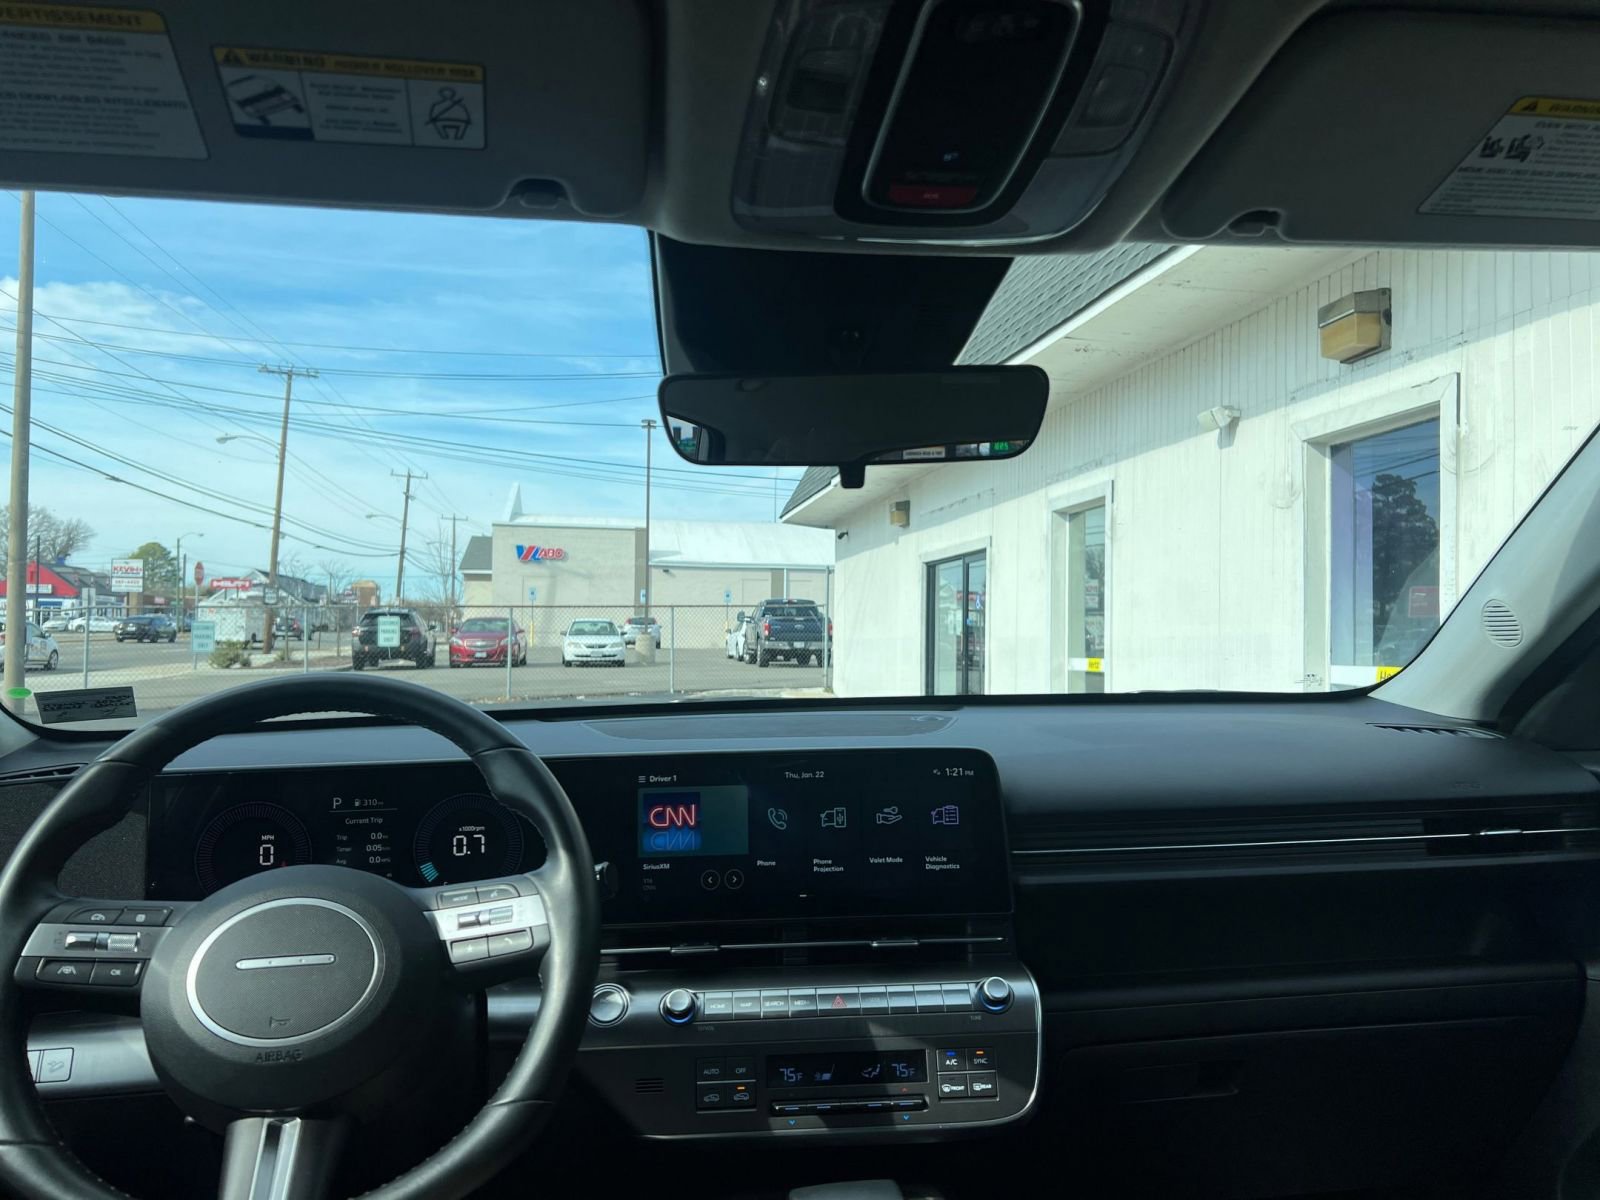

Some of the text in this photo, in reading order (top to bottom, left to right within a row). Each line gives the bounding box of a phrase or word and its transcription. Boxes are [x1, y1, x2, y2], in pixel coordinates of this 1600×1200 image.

[801, 771, 815, 779] Jan.
[816, 770, 825, 778] 22
[945, 767, 964, 777] 1:21
[649, 774, 678, 783] Driver 1
[333, 797, 342, 809] P
[649, 803, 696, 827] CNN
[345, 816, 383, 825] Current Trip
[453, 834, 485, 856] 0.7
[259, 843, 274, 866] 0
[925, 855, 947, 863] Vehicle
[813, 858, 833, 866] Phone
[869, 856, 885, 864] Valet
[643, 863, 670, 871] SiriusXM
[813, 865, 844, 873] Projection
[925, 862, 960, 870] Diagnostics
[945, 1058, 958, 1067] A/C
[973, 1057, 989, 1065] SYNC
[703, 1067, 720, 1075] AUTO
[735, 1066, 747, 1075] OFF
